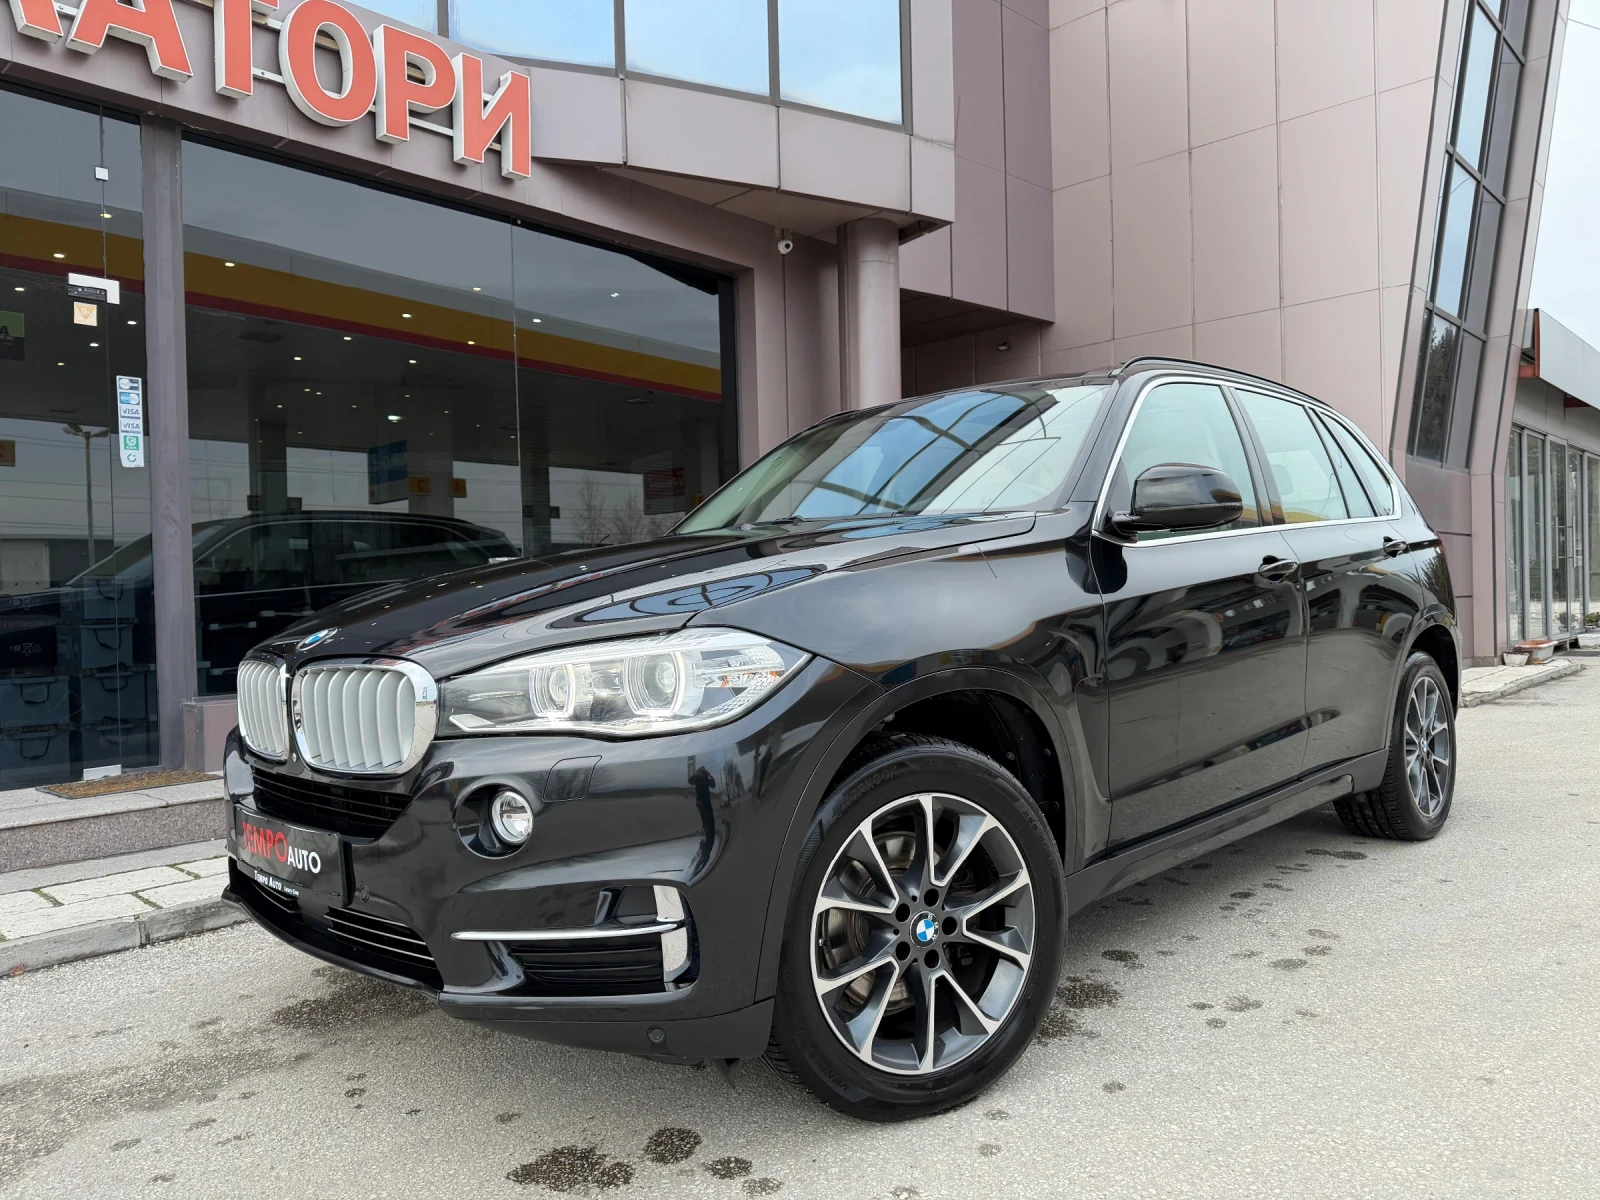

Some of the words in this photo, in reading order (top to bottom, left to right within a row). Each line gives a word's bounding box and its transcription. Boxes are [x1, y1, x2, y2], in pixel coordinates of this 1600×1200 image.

[9, 0, 532, 180] АТОРИ
[123, 422, 141, 430] VISA
[242, 821, 288, 863] TEMPO
[287, 846, 321, 874] AUTO
